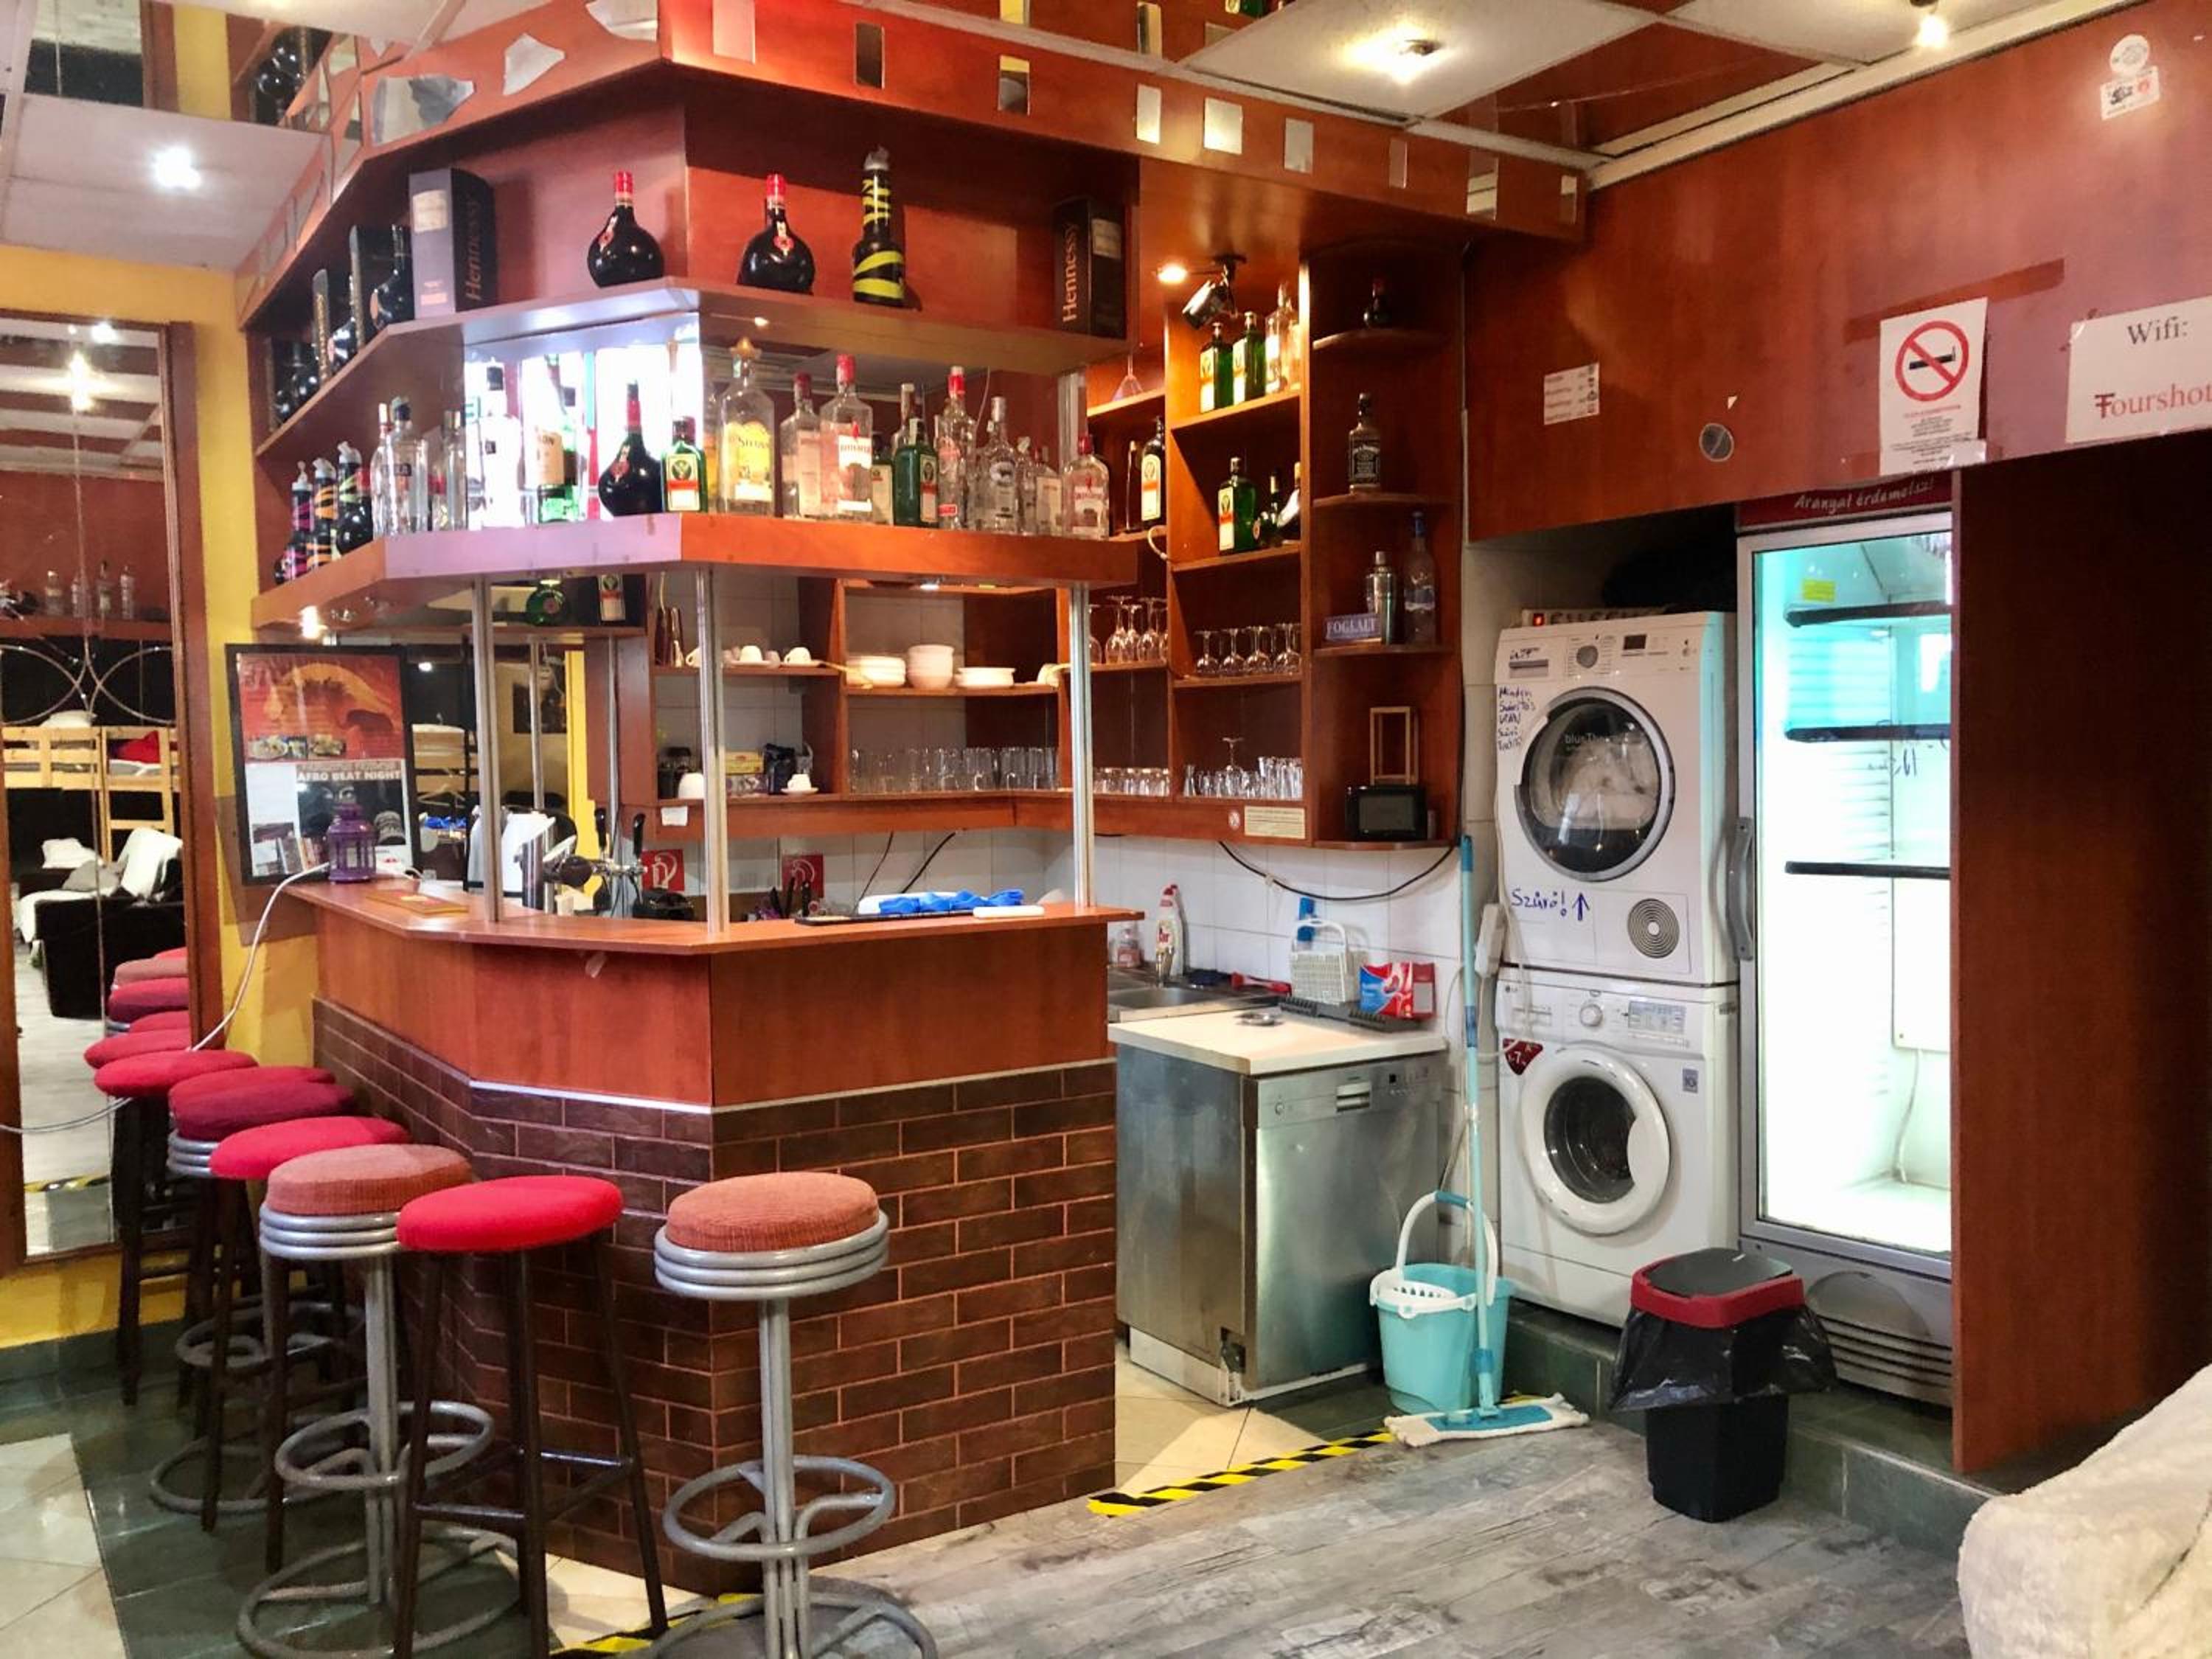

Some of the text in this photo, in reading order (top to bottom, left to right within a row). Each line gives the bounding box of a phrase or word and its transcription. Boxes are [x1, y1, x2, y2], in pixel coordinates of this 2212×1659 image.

[1062, 220, 1078, 323] Hennessy
[2127, 315, 2188, 345] Wifi:
[297, 771, 401, 780] AFRO BEAT NIGHT
